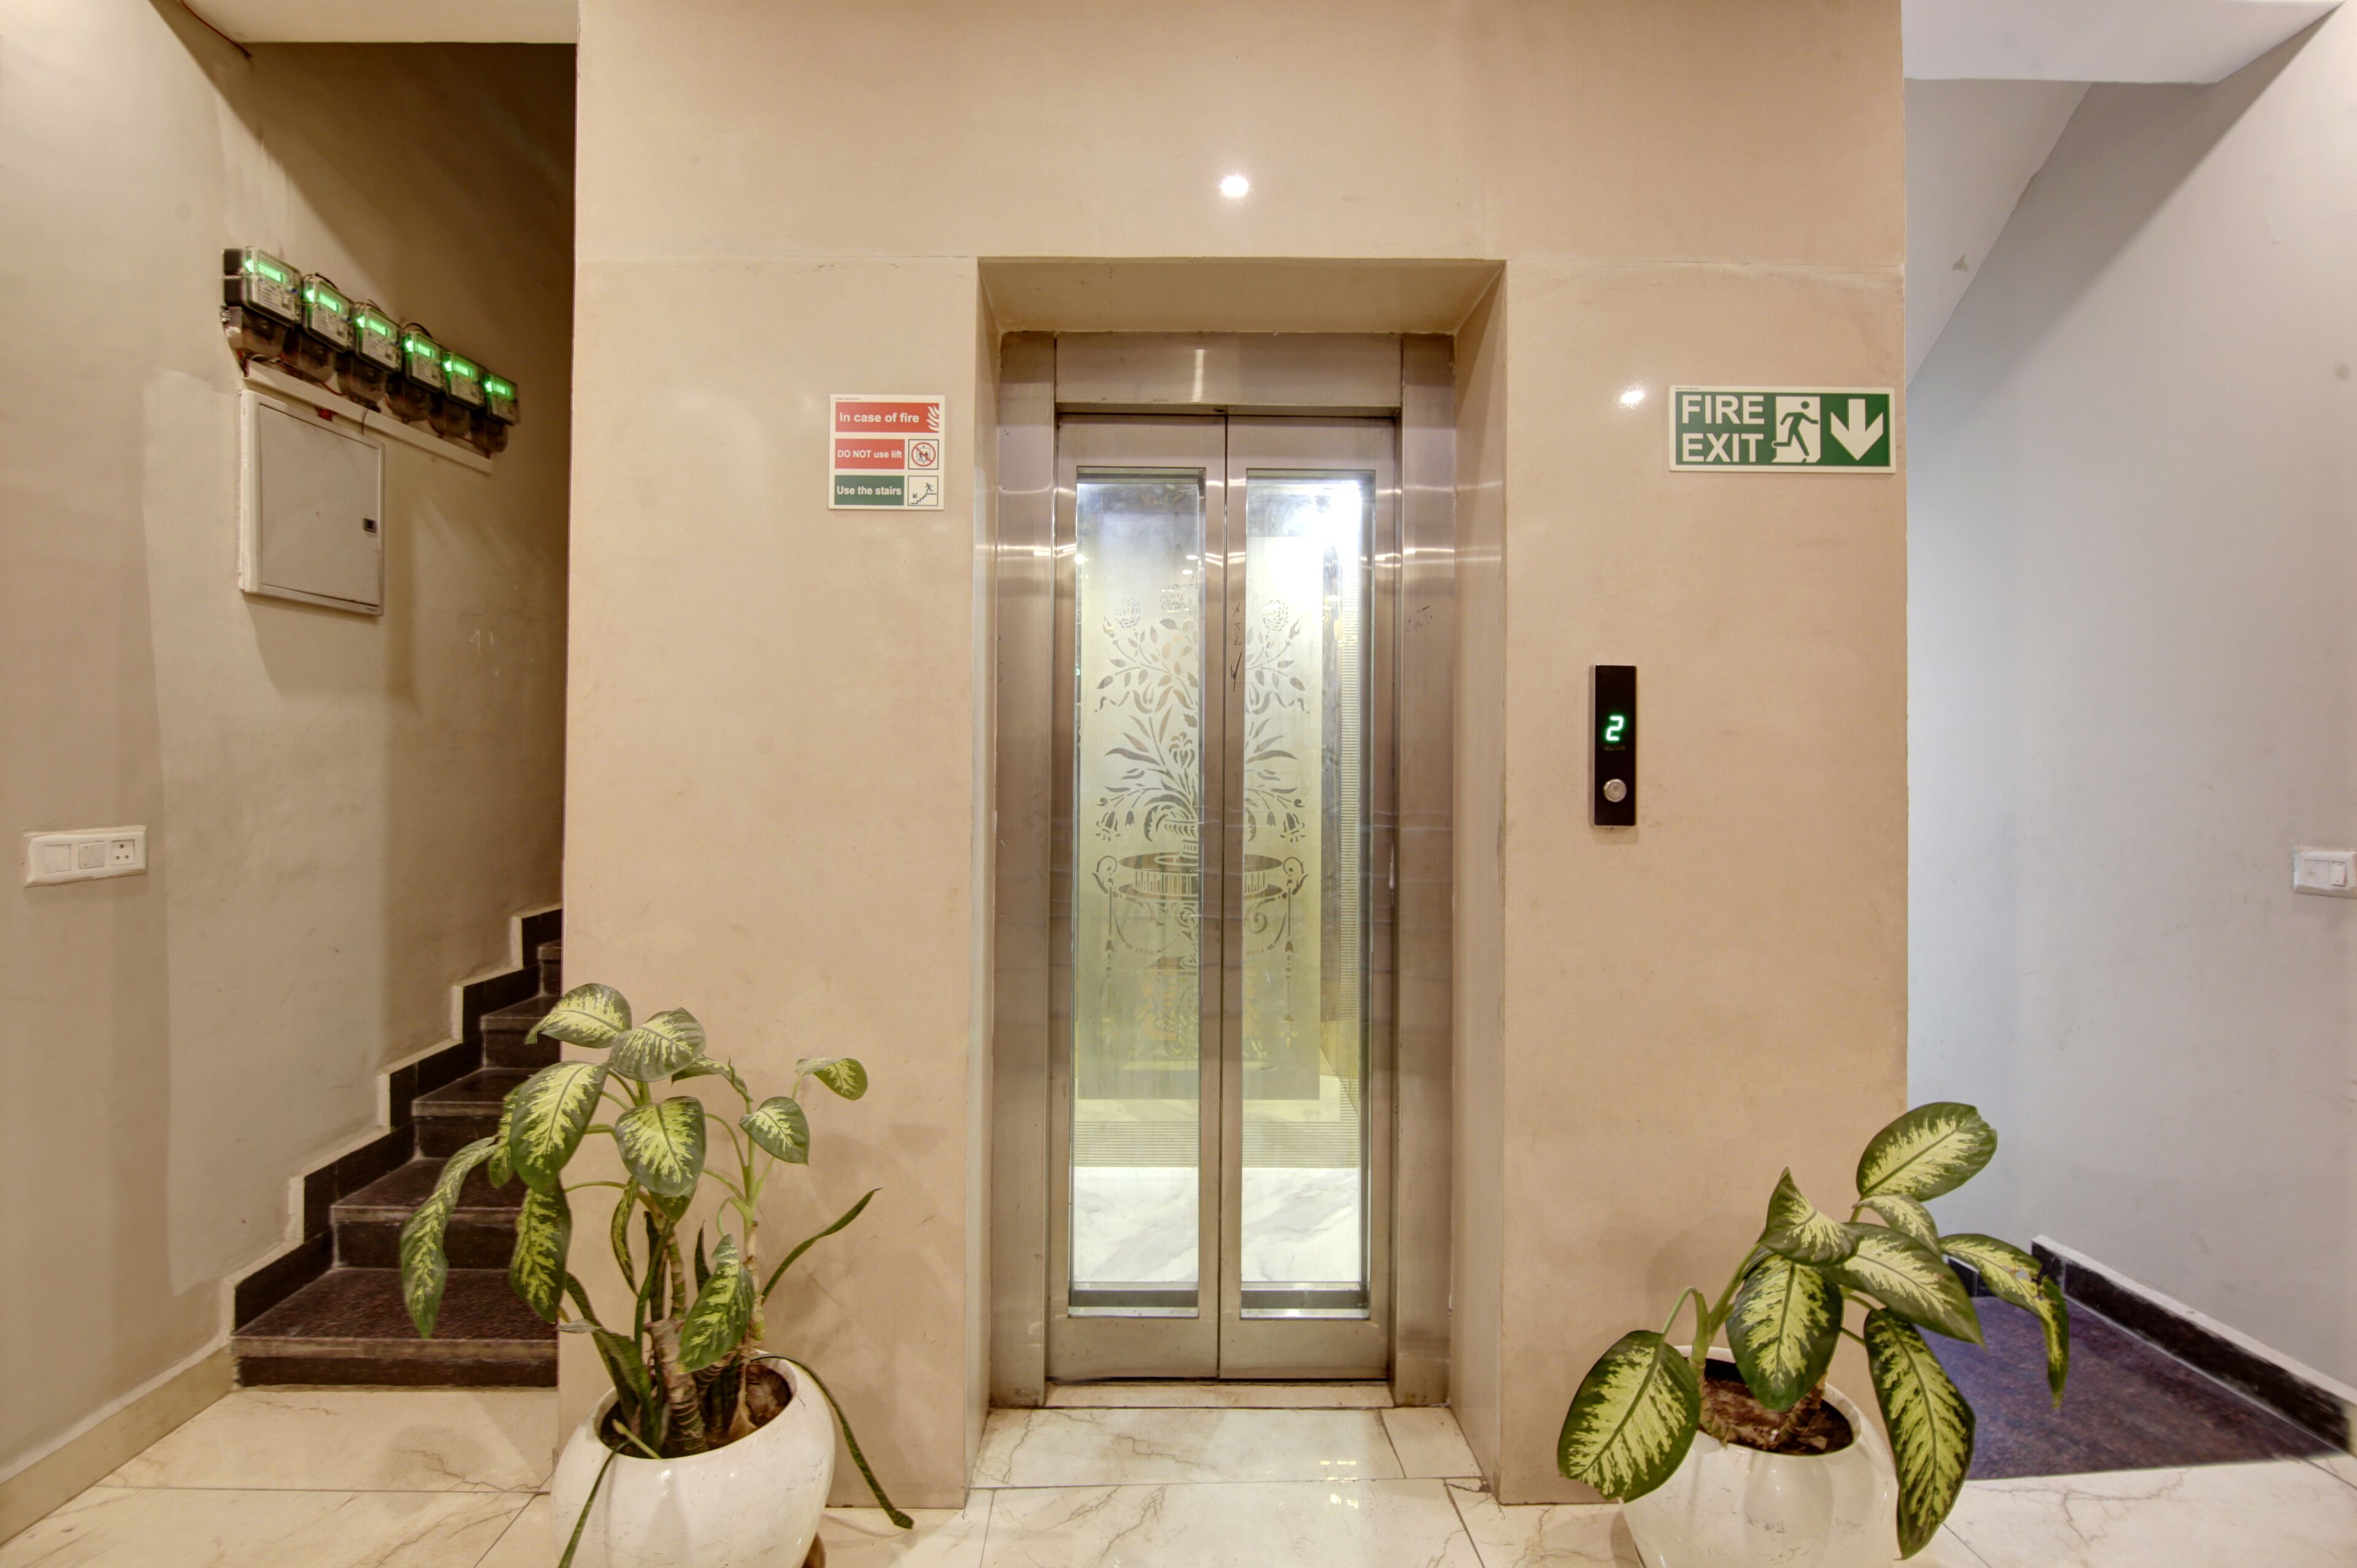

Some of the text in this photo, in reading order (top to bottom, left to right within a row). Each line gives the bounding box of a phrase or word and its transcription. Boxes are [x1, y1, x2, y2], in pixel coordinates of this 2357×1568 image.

[840, 412, 850, 422] In
[885, 412, 897, 422] of
[900, 413, 919, 423] fire
[1682, 395, 1765, 425] FIRE
[1682, 433, 1764, 462] EXIT
[837, 485, 902, 495] Use the stairs
[1606, 716, 1624, 741] 2
